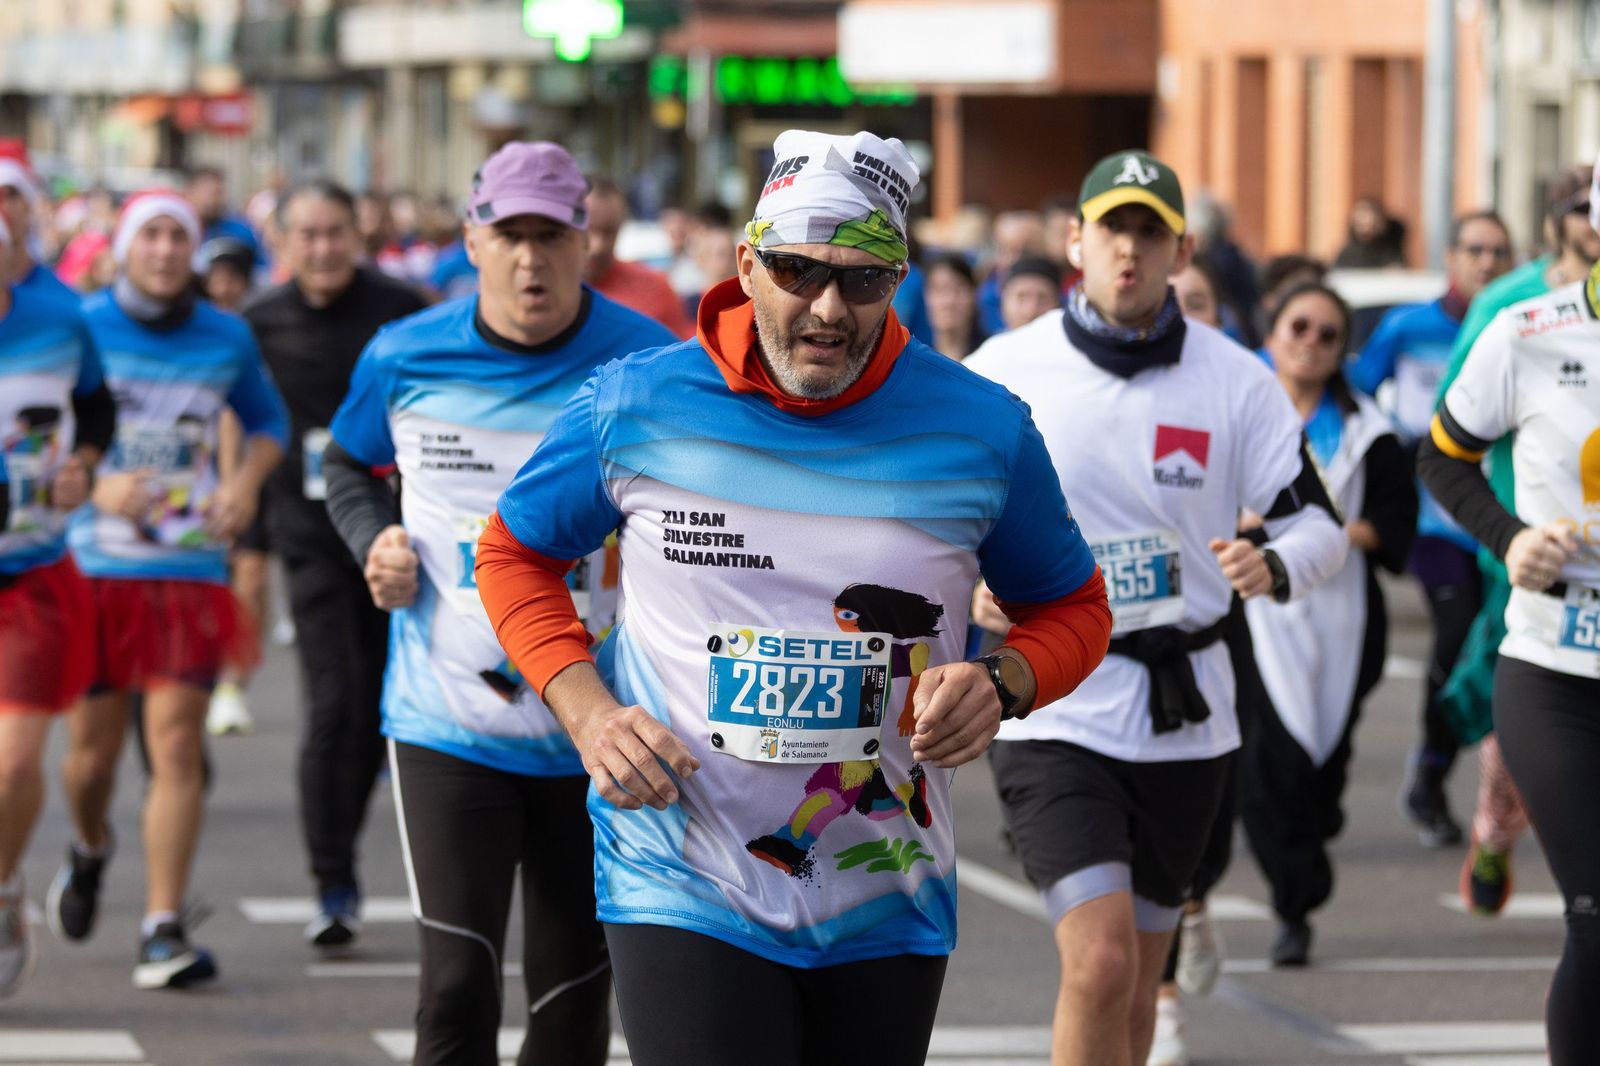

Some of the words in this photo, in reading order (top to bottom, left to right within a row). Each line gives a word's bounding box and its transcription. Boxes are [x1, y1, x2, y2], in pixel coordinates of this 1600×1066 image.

[661, 510, 685, 525] XLI
[689, 511, 726, 528] SAN
[662, 528, 745, 549] SILVESTRE
[662, 546, 776, 570] SALMANTINA
[757, 635, 872, 661] SETEL
[730, 661, 845, 719] 2823
[767, 716, 804, 729] EONLU
[781, 739, 829, 750] Ayuntamiento
[781, 750, 790, 758] de
[791, 750, 828, 759] Salamanca
